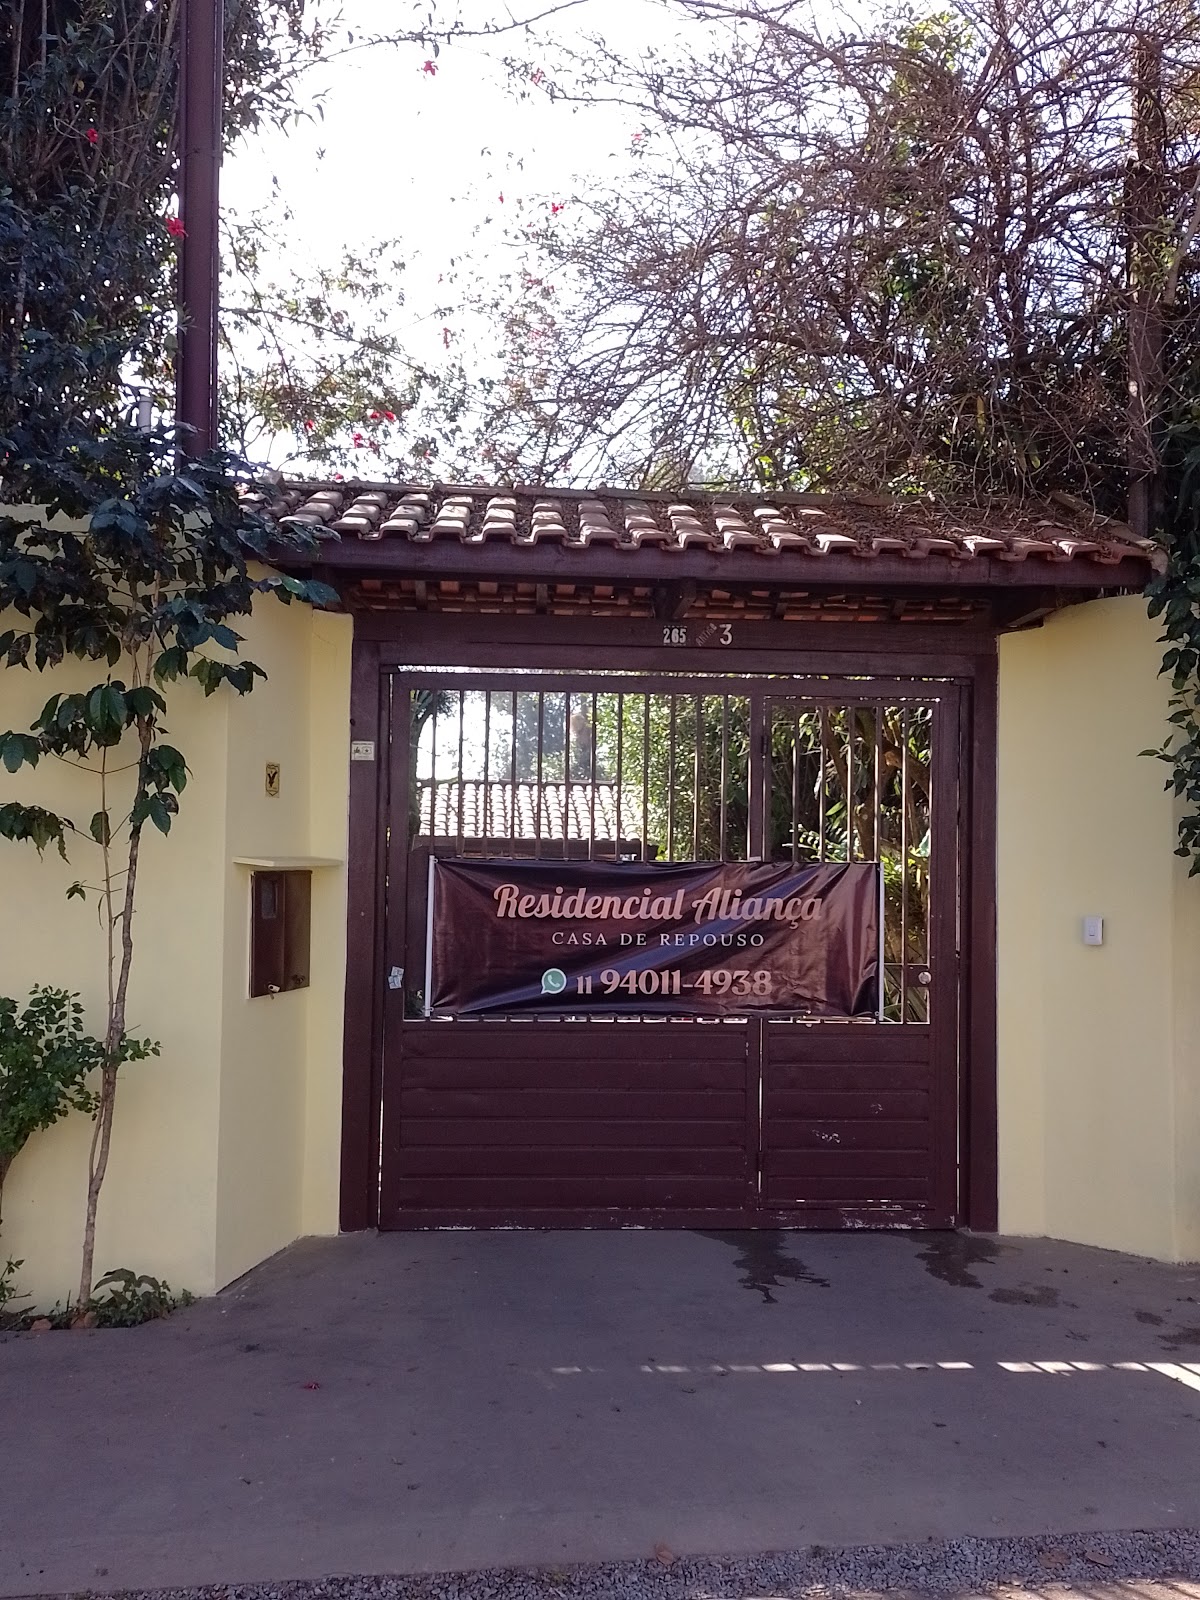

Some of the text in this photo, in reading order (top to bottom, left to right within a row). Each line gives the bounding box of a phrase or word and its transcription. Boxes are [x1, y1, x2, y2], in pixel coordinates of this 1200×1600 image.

[663, 628, 687, 643] 265
[719, 624, 733, 645] 3
[493, 883, 823, 930] Residencial Aliança
[551, 931, 765, 947] CASA DE REPOUSO
[576, 969, 773, 996] 11 94011-4938
